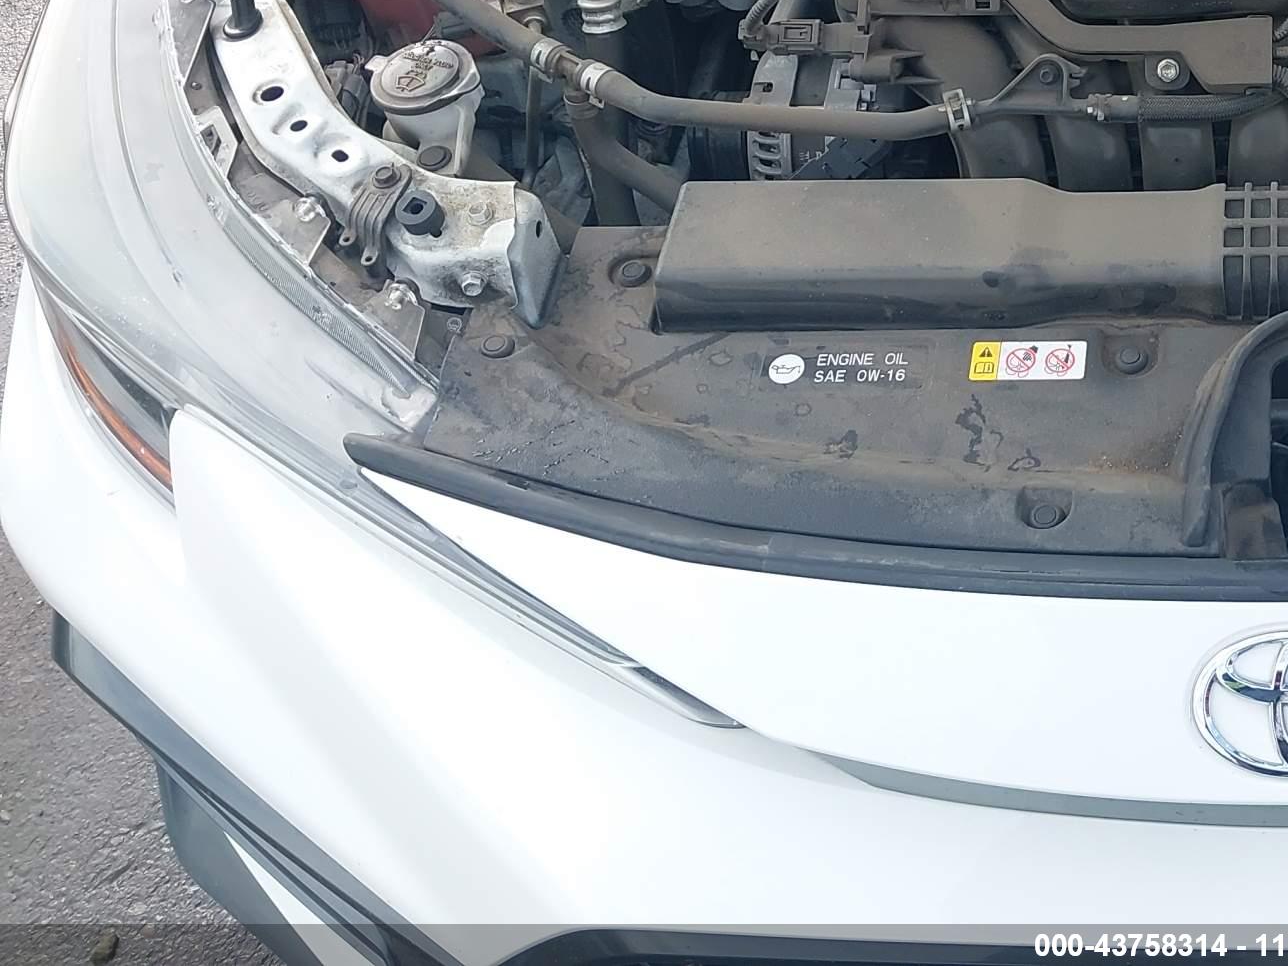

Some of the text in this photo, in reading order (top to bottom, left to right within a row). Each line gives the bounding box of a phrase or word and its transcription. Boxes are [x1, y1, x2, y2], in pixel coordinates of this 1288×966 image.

[816, 352, 909, 367] ENGINE OIL
[813, 369, 906, 383] SAE 0W-16
